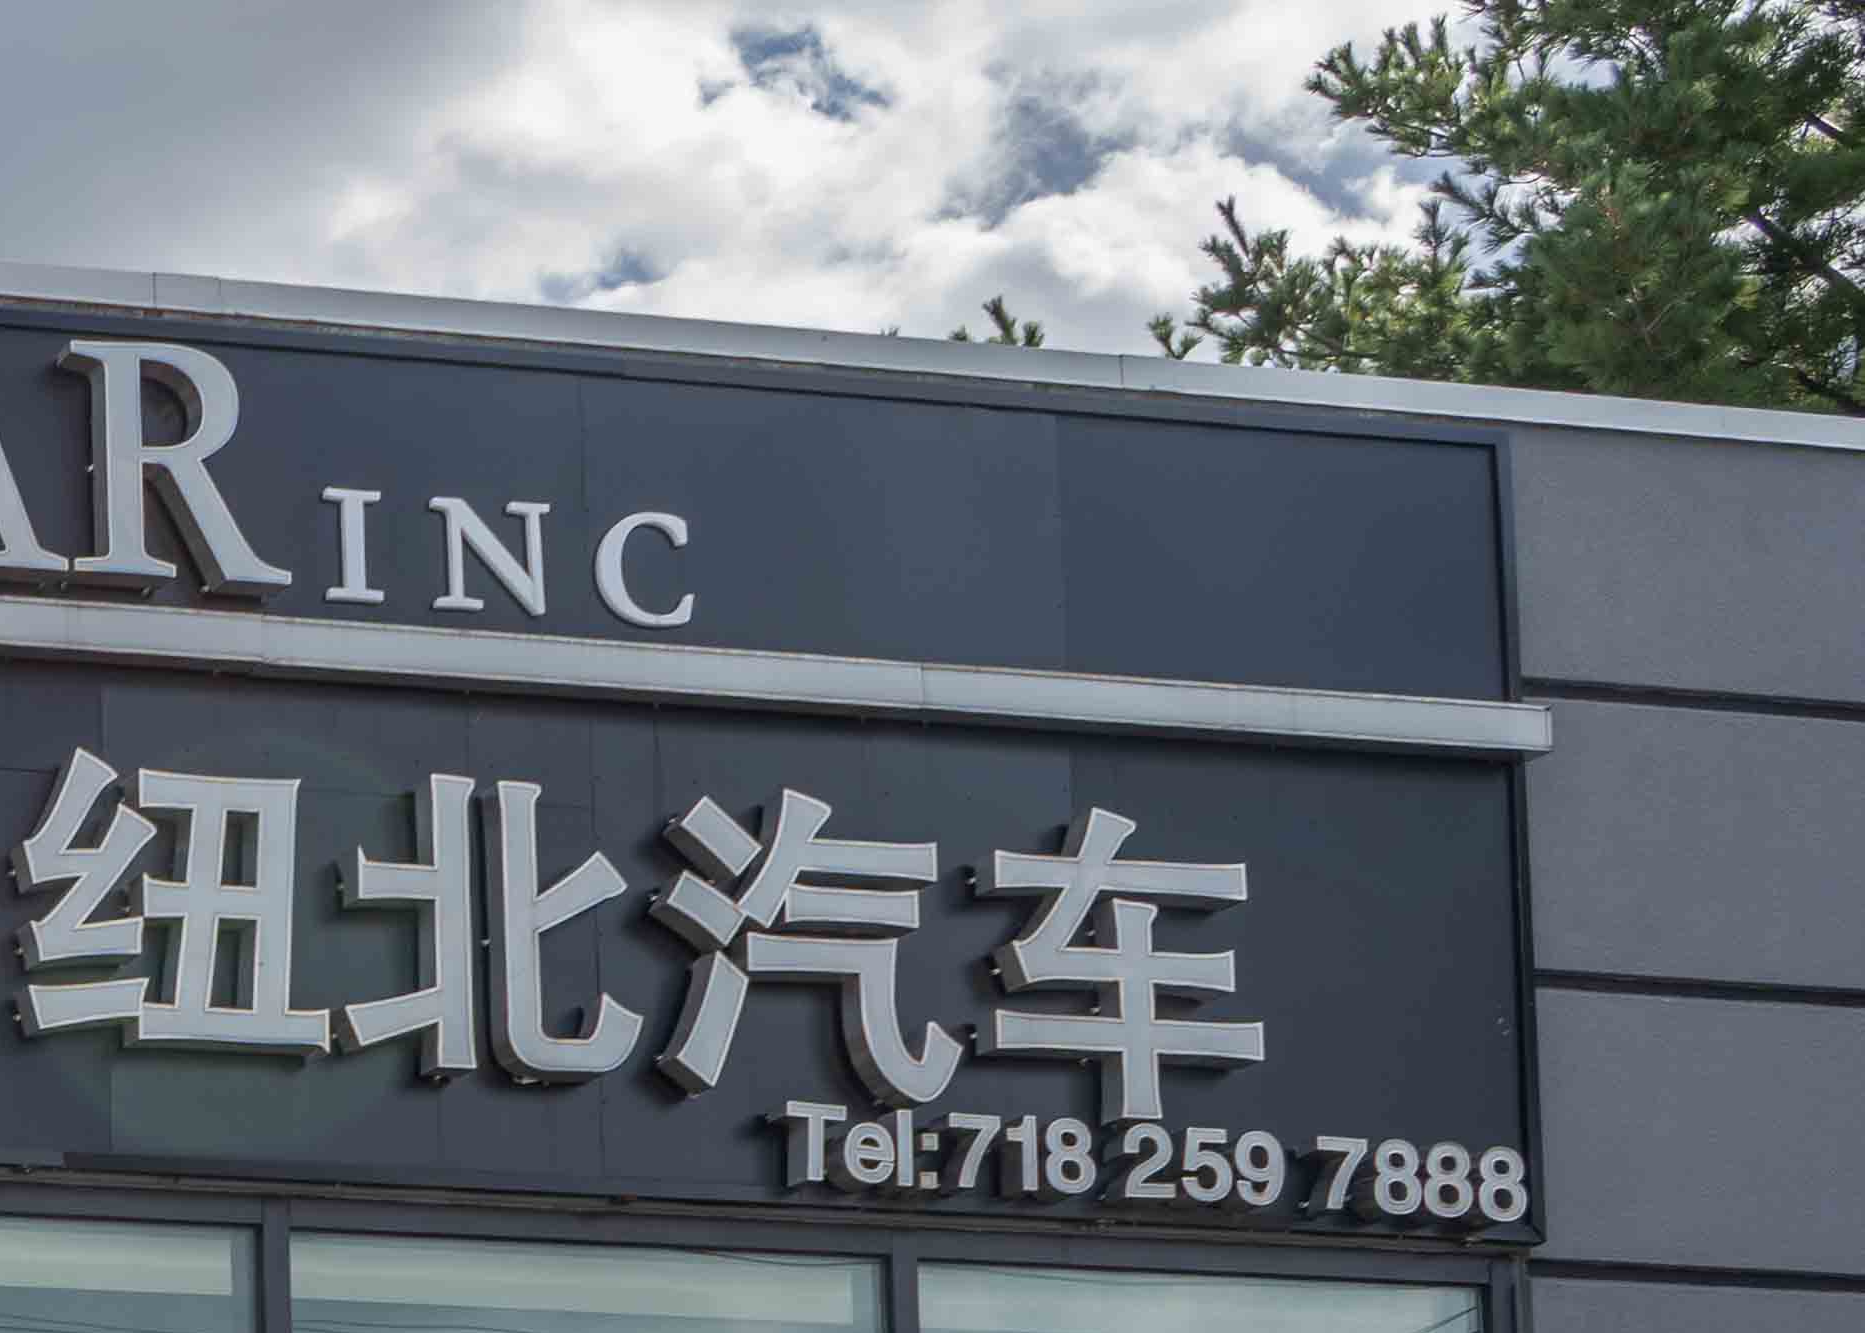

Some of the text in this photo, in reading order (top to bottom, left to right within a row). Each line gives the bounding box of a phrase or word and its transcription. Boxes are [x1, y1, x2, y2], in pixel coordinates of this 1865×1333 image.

[324, 486, 696, 630] INC
[12, 745, 1266, 1122] 纽北汽车
[1119, 1121, 1285, 1212] 259
[1315, 1133, 1531, 1226] 7888
